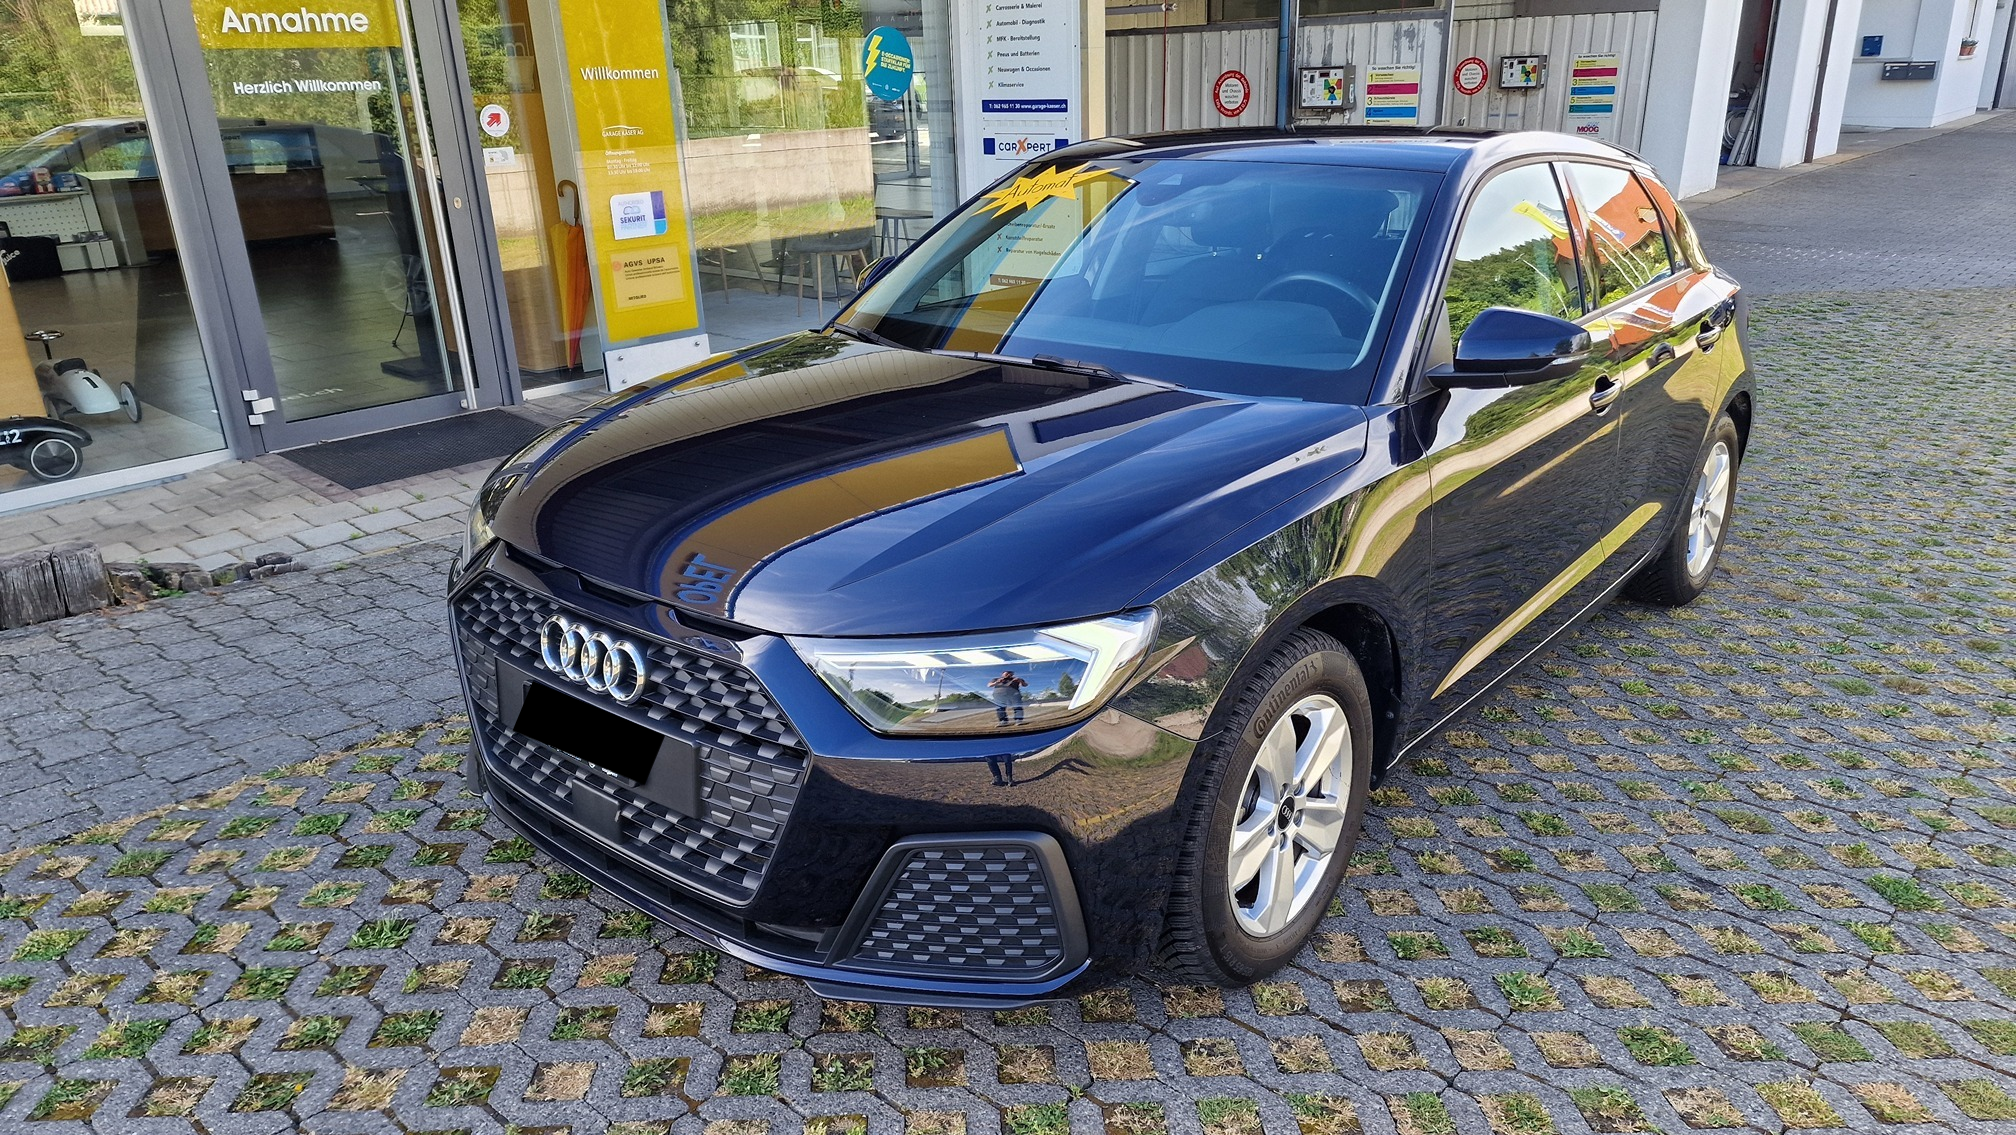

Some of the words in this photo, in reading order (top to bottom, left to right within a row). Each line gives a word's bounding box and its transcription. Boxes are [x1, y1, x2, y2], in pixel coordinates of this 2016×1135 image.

[222, 7, 369, 33] Annahme
[1022, 18, 1045, 26] Diagnostik
[580, 66, 659, 80] Willkommen
[233, 81, 293, 94] Herzlich
[294, 80, 382, 92] Willkommen
[1367, 97, 1373, 105] 3
[1001, 174, 1078, 201] Automat
[620, 215, 646, 224] SEKURIT
[624, 260, 643, 268] AGVS
[647, 257, 665, 265] UPSA
[1253, 663, 1310, 739] Continental
